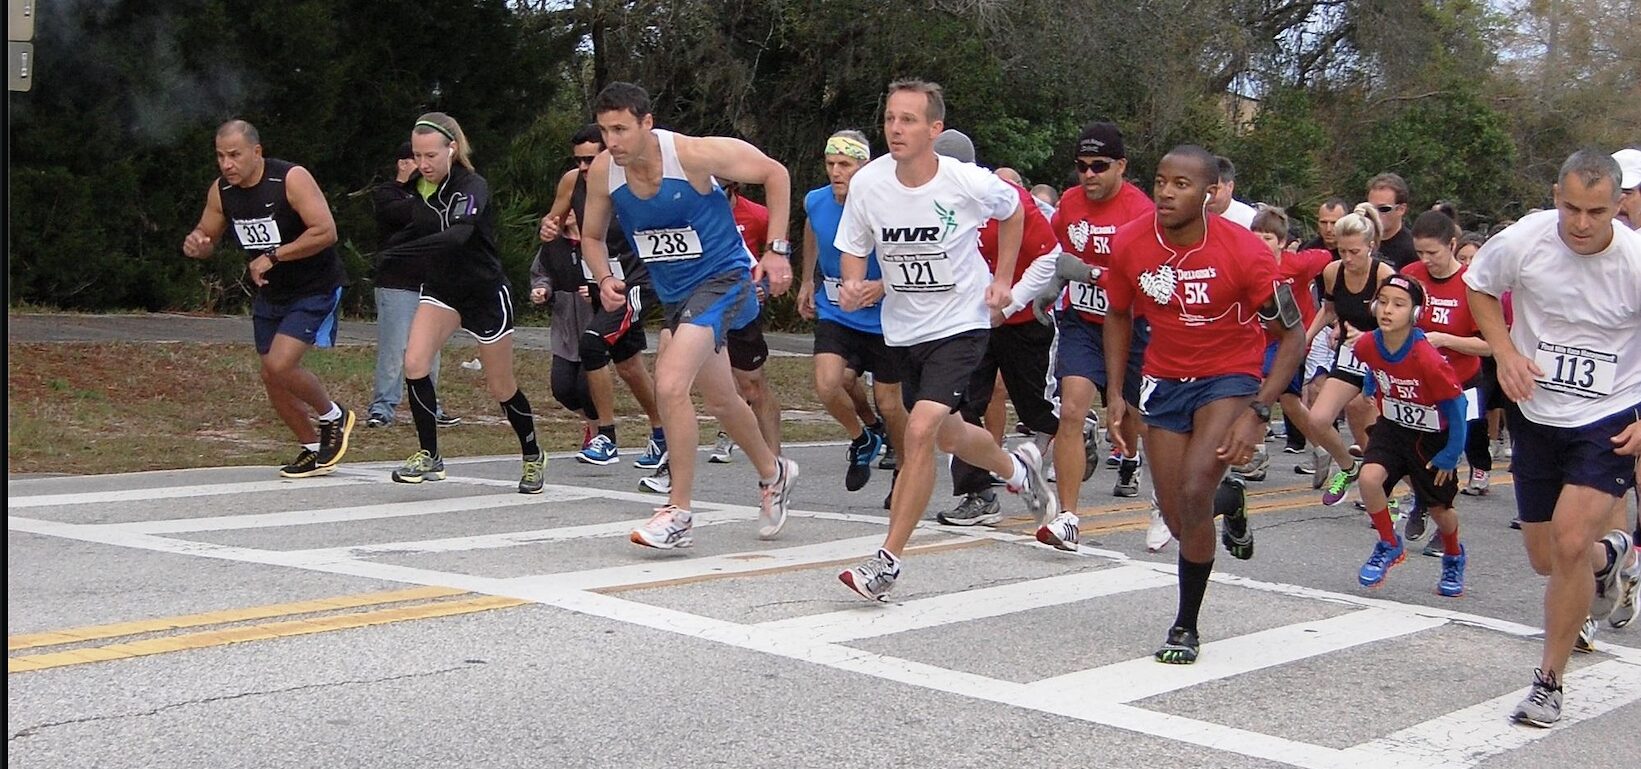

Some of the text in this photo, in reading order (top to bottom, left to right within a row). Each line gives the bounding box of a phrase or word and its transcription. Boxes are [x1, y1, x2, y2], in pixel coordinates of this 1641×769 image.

[243, 223, 271, 244] 313
[647, 233, 689, 255] 238
[881, 226, 940, 242] WVR
[1093, 235, 1111, 254] 5K
[898, 261, 939, 285] 121
[1078, 283, 1106, 310] 275
[1184, 282, 1211, 305] 5K
[1431, 307, 1451, 325] 5K
[1551, 354, 1596, 388] 113
[1396, 385, 1418, 398] 5K
[1393, 404, 1427, 426] 182
